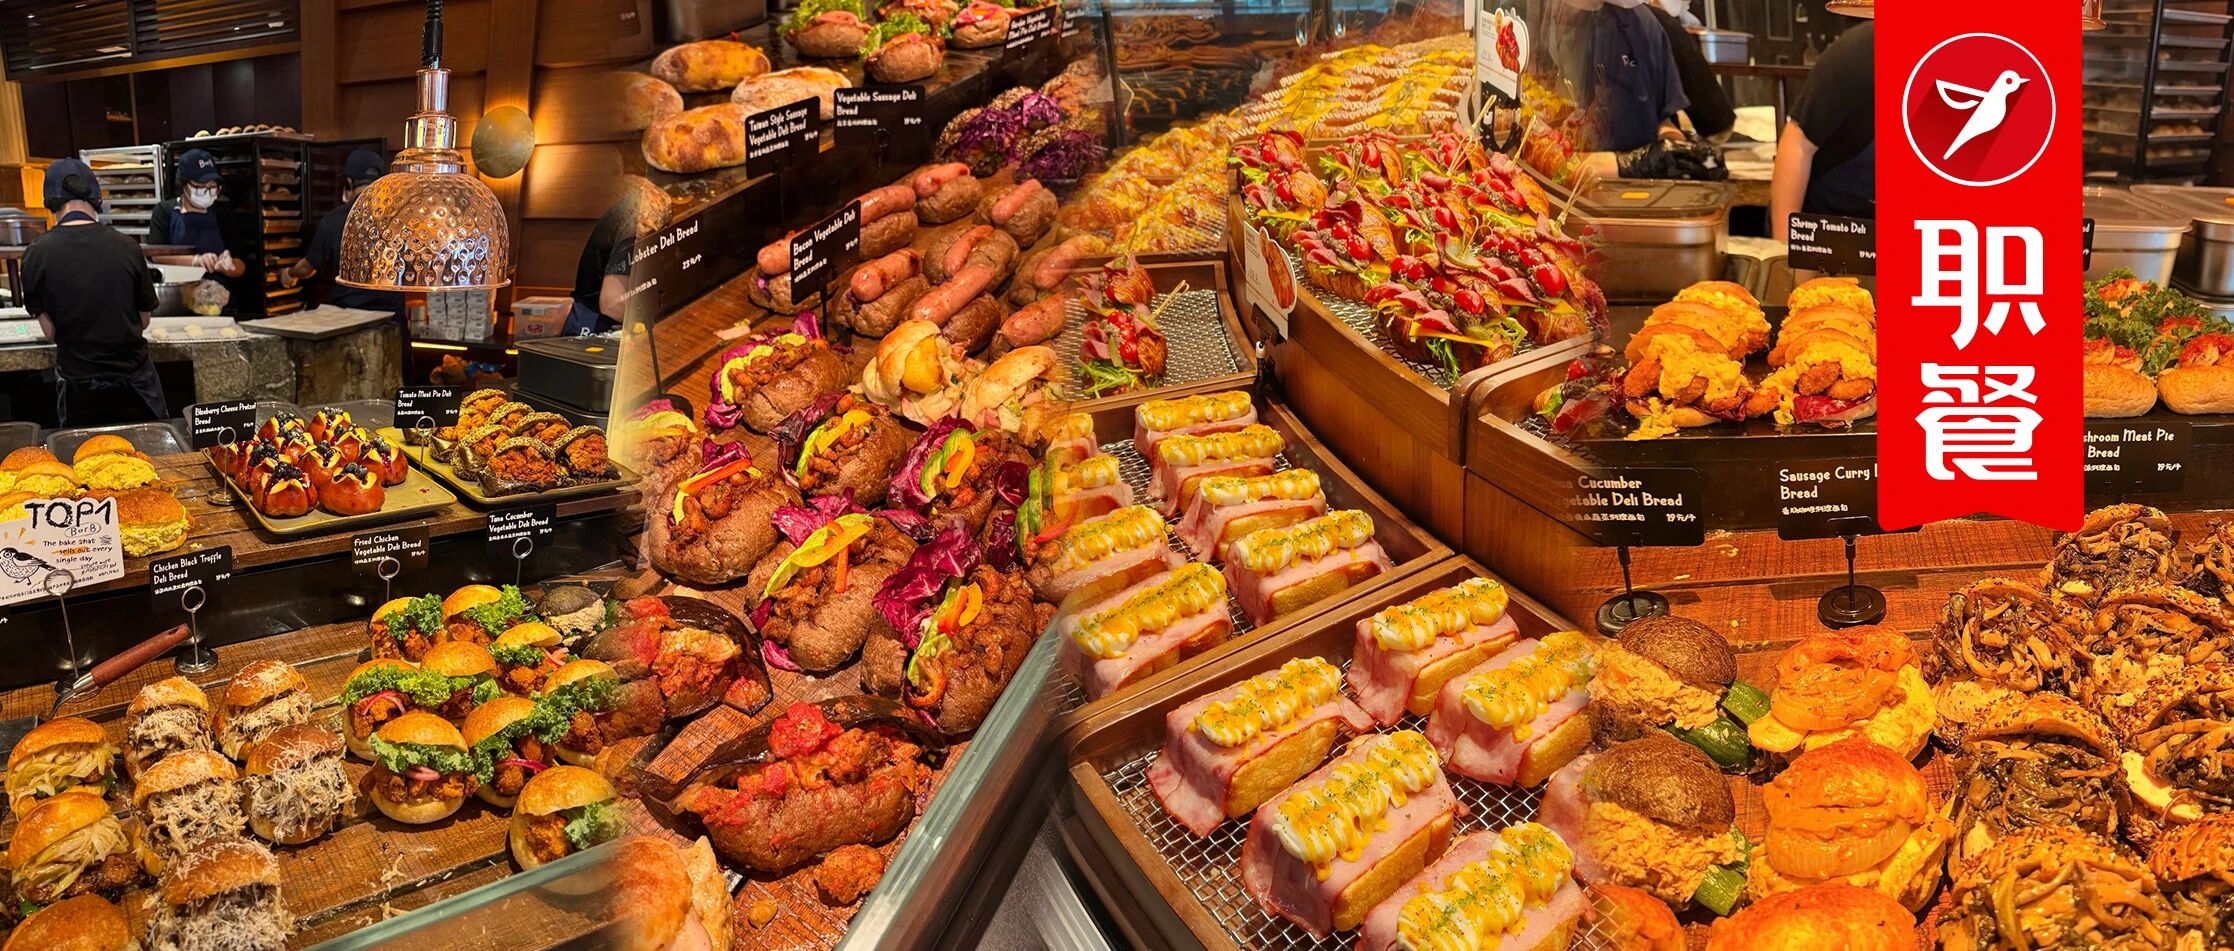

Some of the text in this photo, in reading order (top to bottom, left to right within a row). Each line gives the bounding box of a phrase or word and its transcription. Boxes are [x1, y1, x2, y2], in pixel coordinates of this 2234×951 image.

[836, 89, 917, 105] Vegetable Sausage Deli
[769, 111, 785, 126] Style
[785, 107, 808, 121] Sausage
[836, 105, 859, 116] Bread
[748, 118, 807, 147] Vegetable Deli Bread
[793, 208, 856, 256] Bacon Vegetable Deli
[1790, 217, 1867, 235] Shrimp Tomato Deli
[1790, 228, 1815, 242] Bread
[628, 244, 658, 266] Lobster
[660, 232, 675, 250] Deli
[676, 220, 699, 242] Bread
[793, 249, 813, 271] Bread
[397, 399, 413, 408] Bread
[195, 416, 211, 426] Bread
[2122, 428, 2152, 442] Meat
[2155, 428, 2175, 441] Pie
[2087, 445, 2121, 458] Bread
[2157, 462, 2182, 471] 19元/个
[1577, 475, 1643, 489] Cucumber
[1779, 468, 1831, 483] Sausage
[1834, 466, 1870, 481] Curry
[1611, 492, 1639, 506] Deli
[1642, 491, 1683, 506] Bread
[1780, 485, 1818, 500] Bread
[505, 511, 533, 520] Cucumber
[1665, 512, 1696, 522] 19元/个
[488, 517, 549, 533] Vegetable Deli Bread
[353, 534, 399, 547] Fried Chicken
[353, 539, 422, 556] Vegetable Deli Bread
[59, 545, 113, 555] sells out every
[56, 556, 78, 564] single
[153, 552, 222, 573] Chicken Black Truffle
[153, 569, 188, 585] Deli Bread
